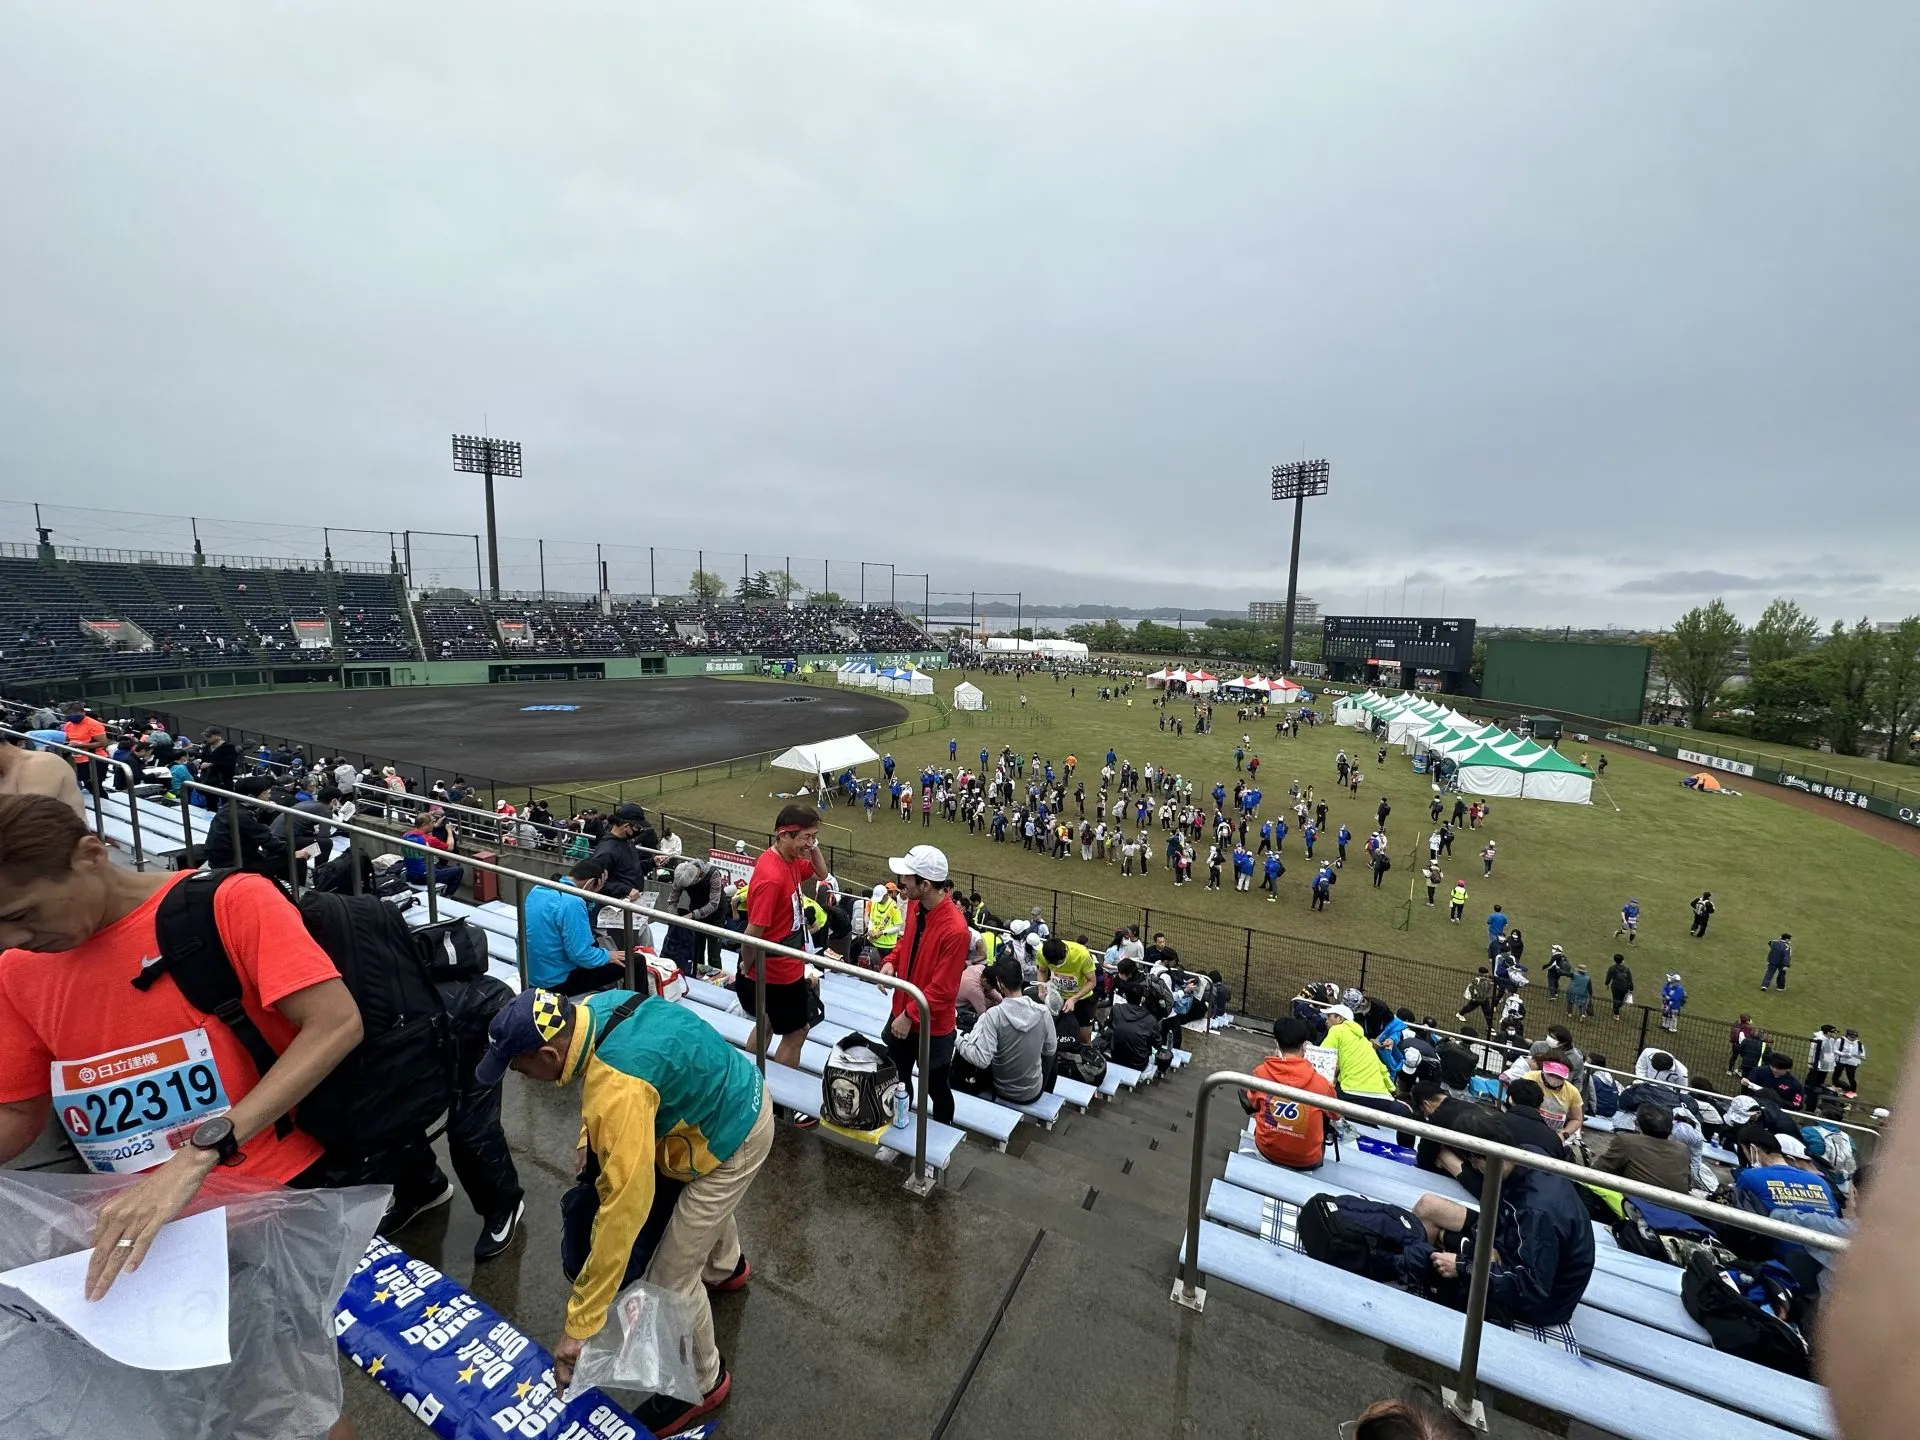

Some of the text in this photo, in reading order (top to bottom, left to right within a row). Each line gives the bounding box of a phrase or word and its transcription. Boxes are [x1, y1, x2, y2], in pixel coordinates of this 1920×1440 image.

[98, 1052, 159, 1078] 日立建機
[69, 1109, 89, 1133] A
[86, 1065, 218, 1137] 22319
[1273, 1100, 1299, 1120] 76
[113, 1138, 155, 1160] 2023
[1767, 1187, 1828, 1200] TEGANUMA
[374, 1263, 426, 1309] Draft
[406, 1259, 443, 1289] One
[399, 1294, 477, 1345] Draft
[422, 1307, 483, 1350] One
[488, 1321, 530, 1362] One
[455, 1337, 514, 1389] Draft
[491, 1367, 557, 1433] Draf
